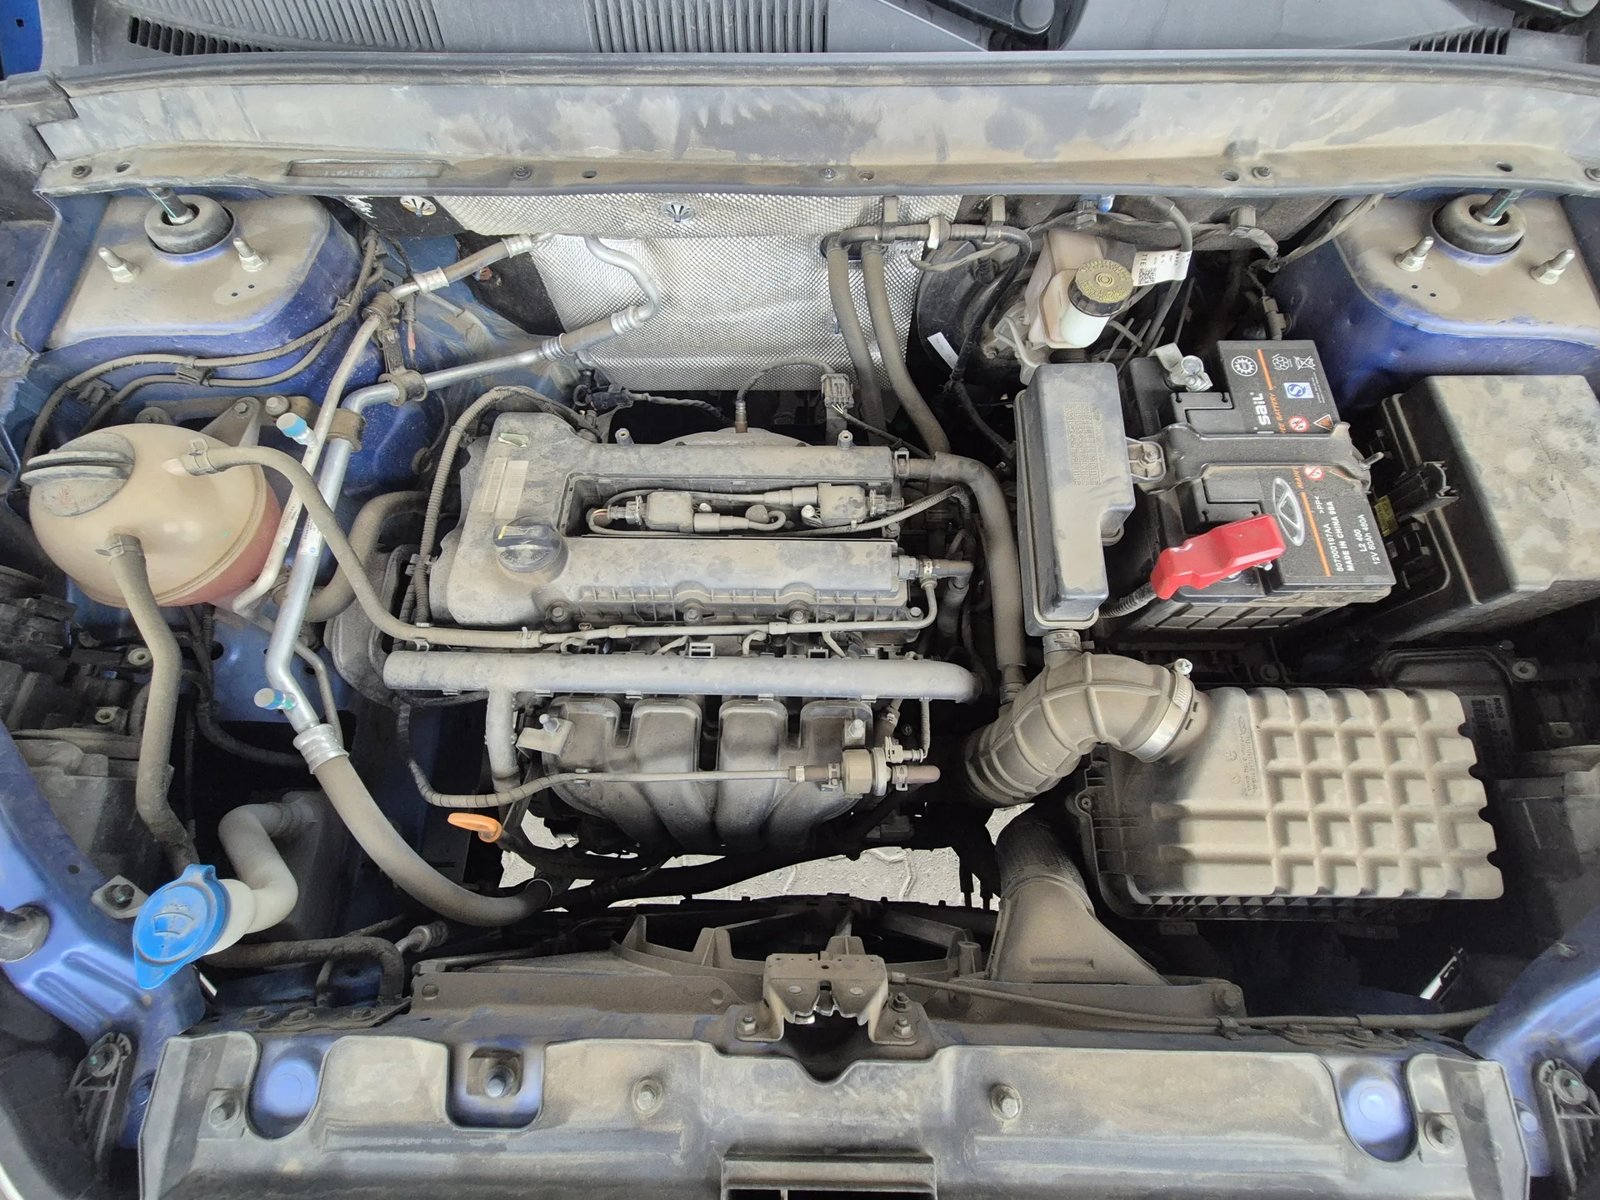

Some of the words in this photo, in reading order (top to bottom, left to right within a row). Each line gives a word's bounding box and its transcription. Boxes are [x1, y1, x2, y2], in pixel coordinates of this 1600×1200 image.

[1331, 516, 1344, 539] CHINA
[1339, 540, 1348, 549] IN
[1342, 550, 1355, 572] MADE
[1369, 551, 1381, 565] 12V
